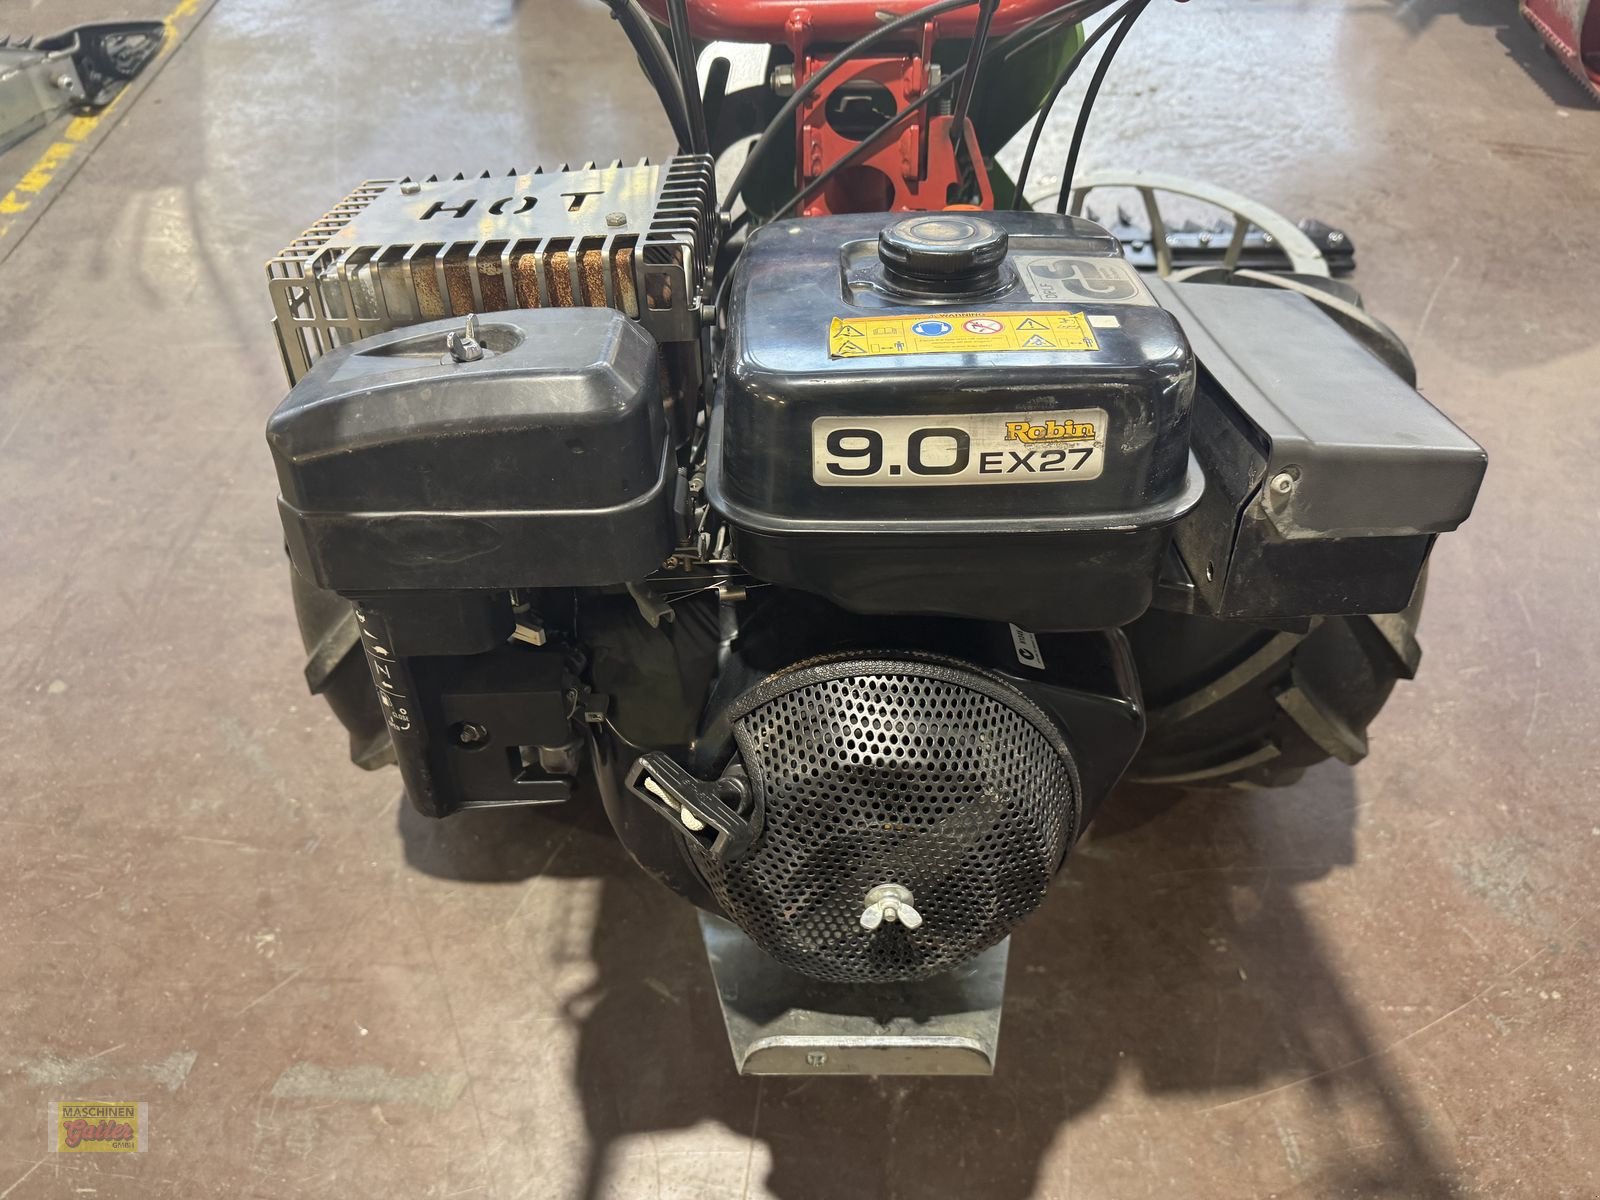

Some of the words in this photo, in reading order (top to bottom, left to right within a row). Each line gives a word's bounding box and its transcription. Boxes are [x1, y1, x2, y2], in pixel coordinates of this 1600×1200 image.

[420, 191, 604, 220] HOT
[1004, 419, 1096, 444] Robin
[826, 428, 971, 476] 9.0
[979, 447, 1094, 474] EX27
